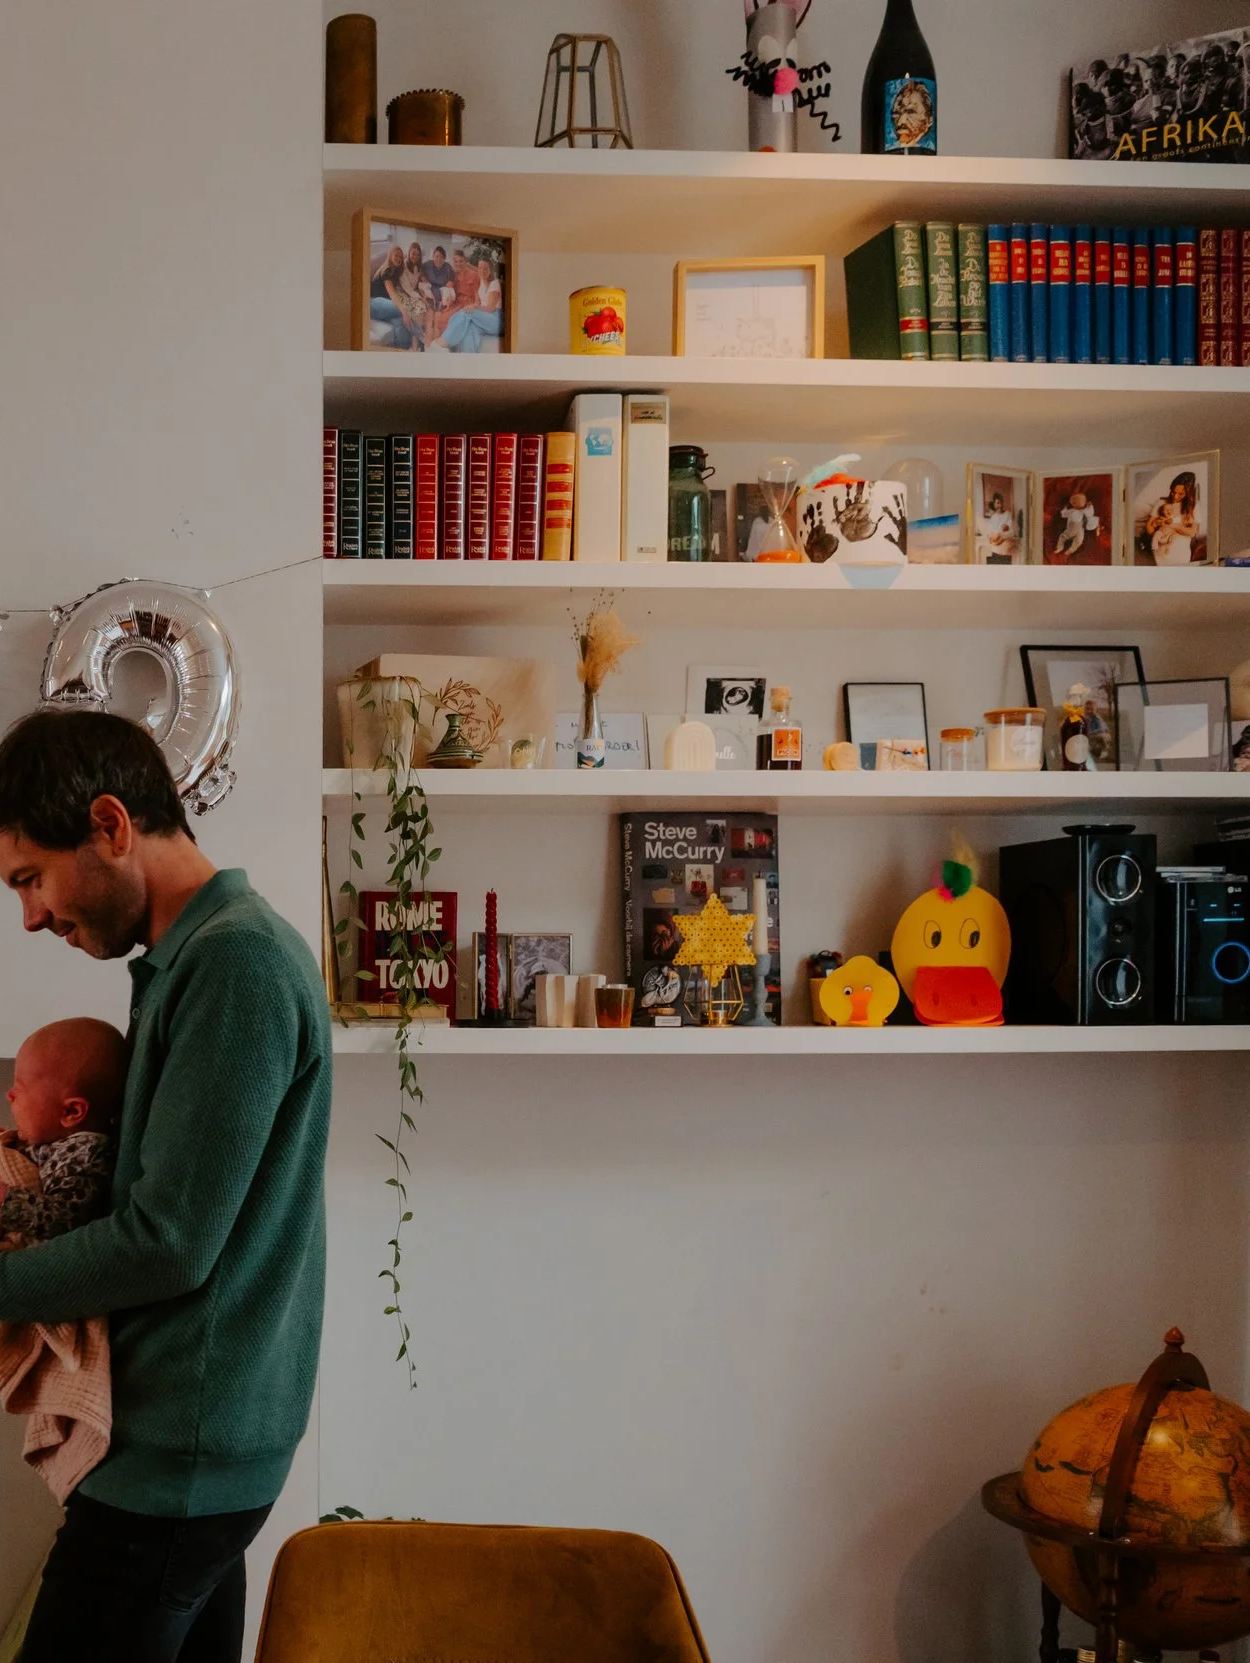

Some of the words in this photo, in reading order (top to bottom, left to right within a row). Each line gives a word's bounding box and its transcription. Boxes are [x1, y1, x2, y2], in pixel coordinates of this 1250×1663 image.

[1109, 111, 1244, 160] AFRIKA
[624, 823, 632, 849] Steve
[644, 821, 697, 840] Steve
[645, 842, 726, 863] McCurry
[624, 851, 633, 891] McCurry
[375, 901, 443, 931] ROME
[624, 899, 633, 930] Voorbij
[626, 931, 632, 942] de
[375, 959, 449, 989] TOKYO
